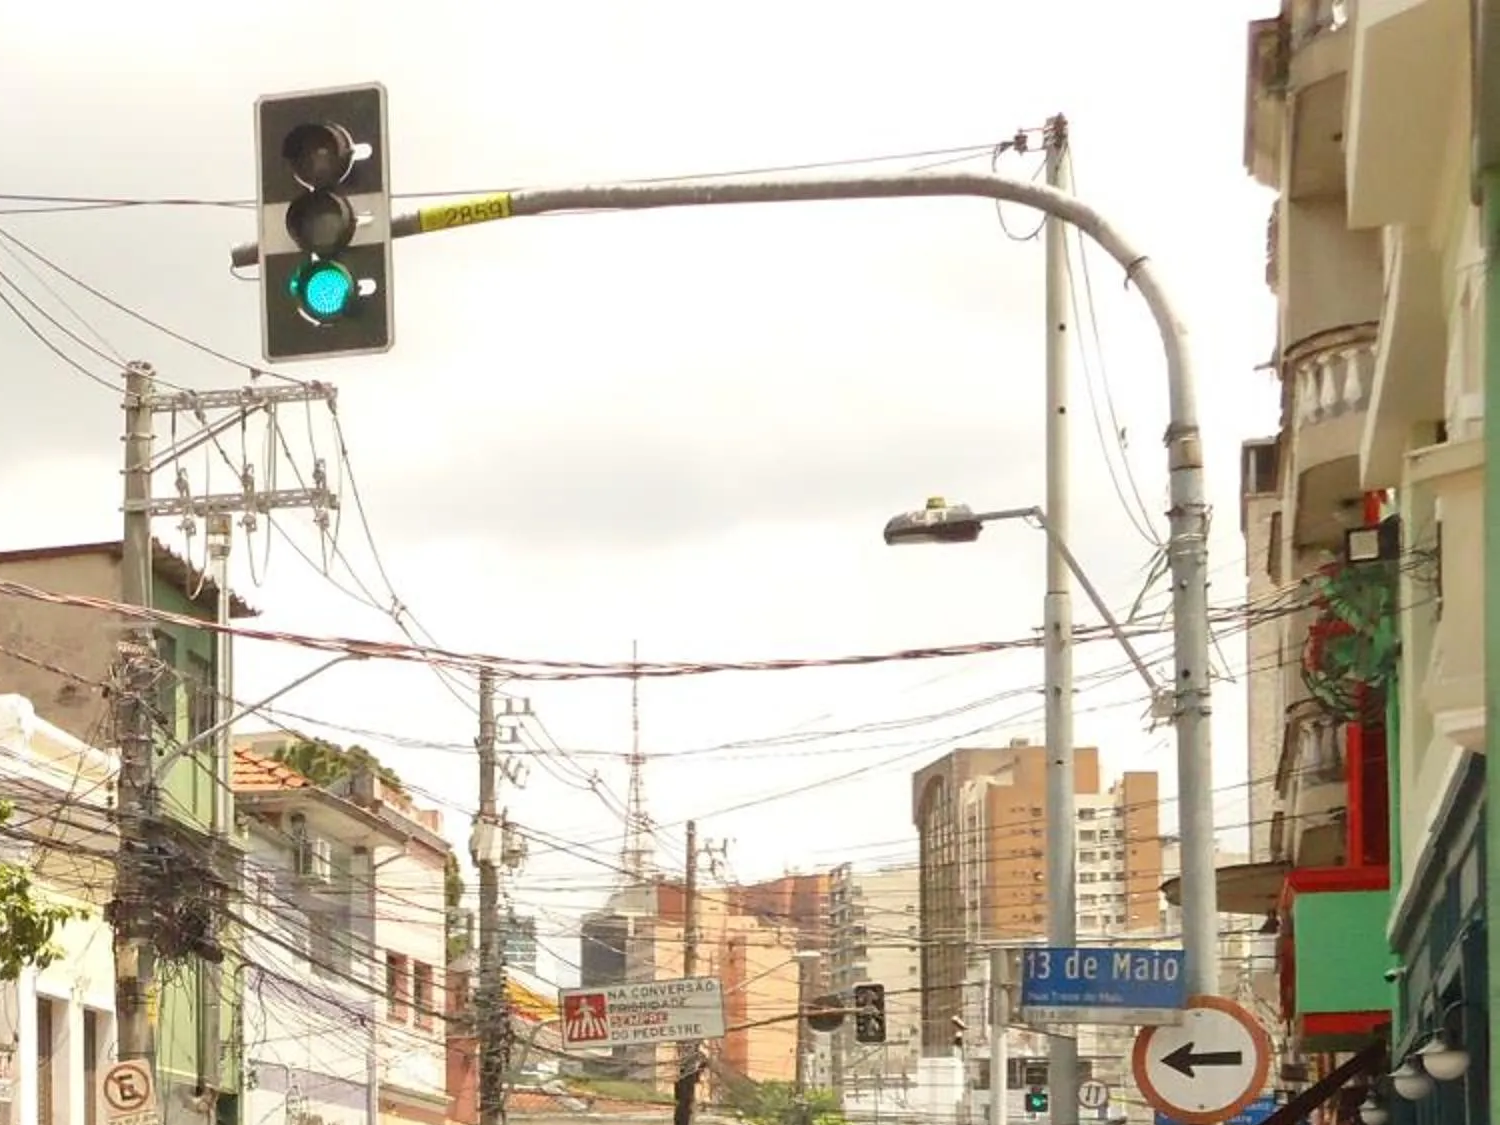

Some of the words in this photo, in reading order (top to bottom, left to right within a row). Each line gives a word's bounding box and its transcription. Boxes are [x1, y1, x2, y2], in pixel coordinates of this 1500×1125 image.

[444, 200, 502, 226] 2859
[1026, 951, 1051, 980] 13
[1064, 950, 1099, 980] de
[1111, 950, 1179, 981] Maio
[607, 988, 628, 1000] NA
[633, 1023, 703, 1040] PEDESTRE
